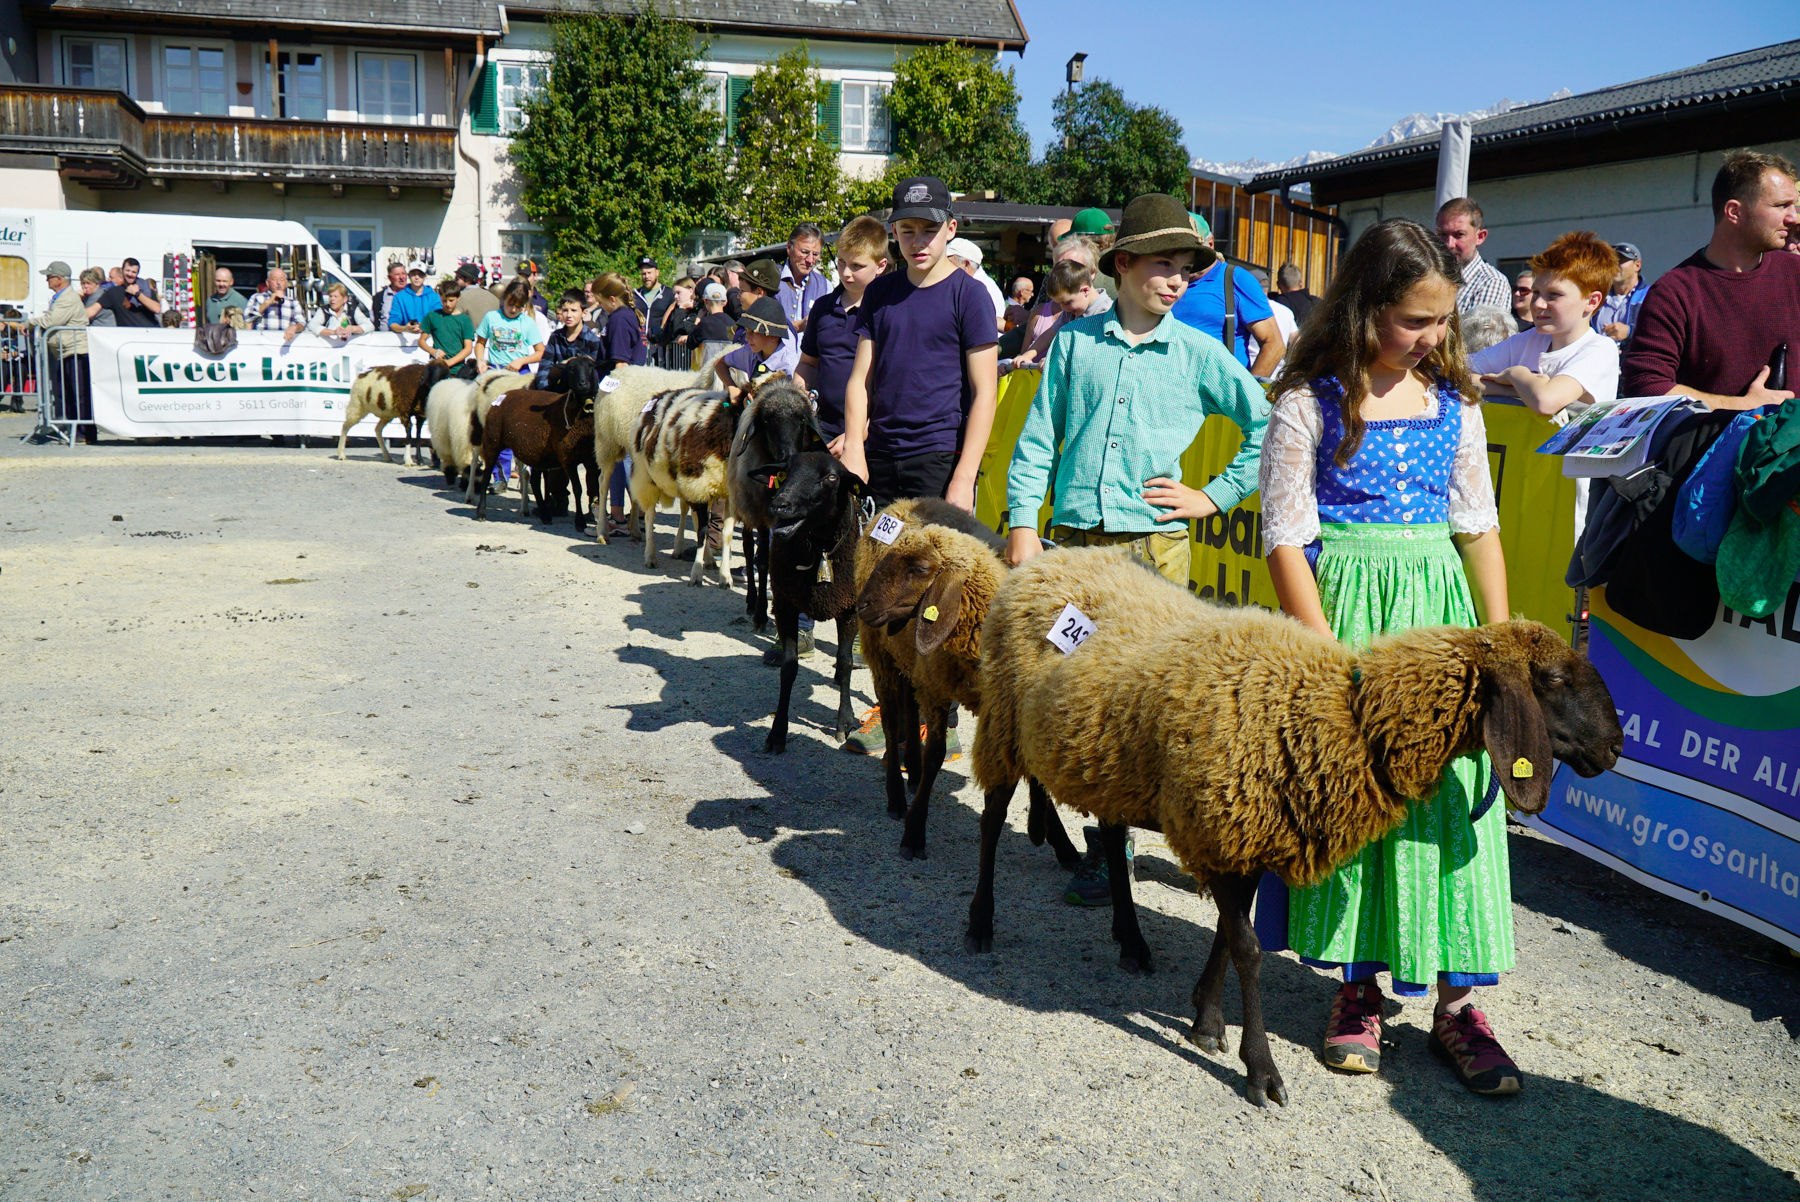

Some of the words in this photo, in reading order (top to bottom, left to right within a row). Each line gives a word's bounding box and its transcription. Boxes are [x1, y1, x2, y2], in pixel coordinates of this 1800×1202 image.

[133, 355, 246, 383] Kreer
[138, 400, 211, 413] Gewerbepark
[216, 400, 222, 410] 3
[239, 399, 265, 410] 5611
[268, 398, 307, 409] Großarl
[877, 516, 898, 534] 268
[1679, 729, 1741, 774] DER
